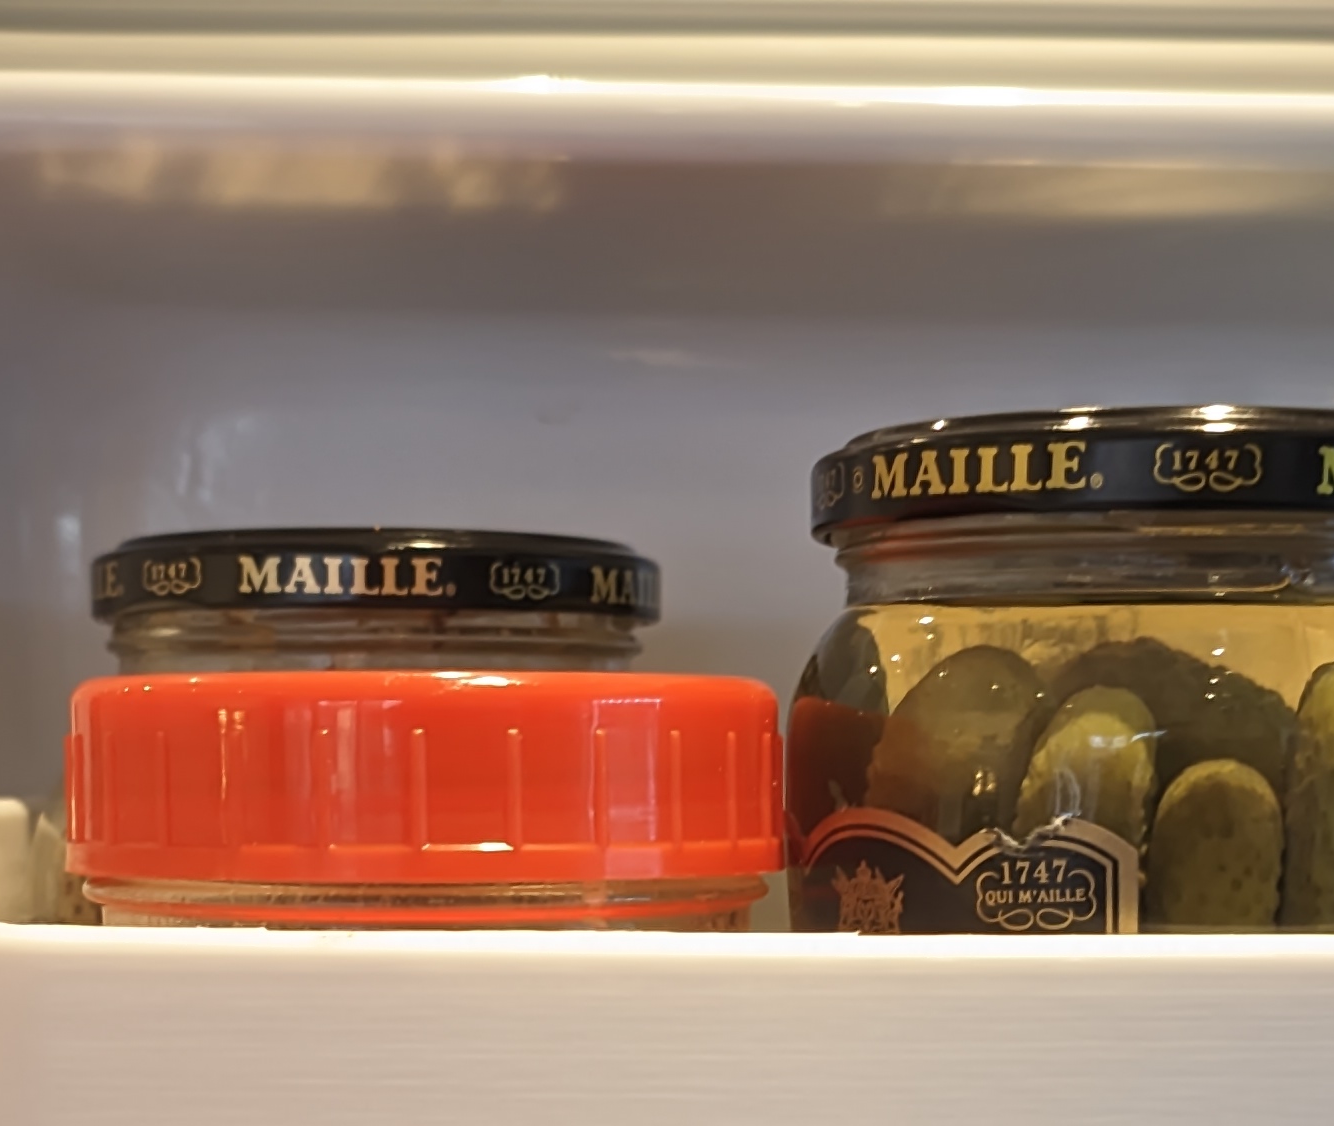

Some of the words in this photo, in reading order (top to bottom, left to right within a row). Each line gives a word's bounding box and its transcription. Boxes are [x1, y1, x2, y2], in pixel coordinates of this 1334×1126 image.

[1172, 450, 1239, 470] 1747
[502, 566, 546, 584] 1747
[1001, 860, 1067, 884] 1747
[985, 891, 1013, 906] QUI
[1018, 888, 1086, 903] M'AILLE
